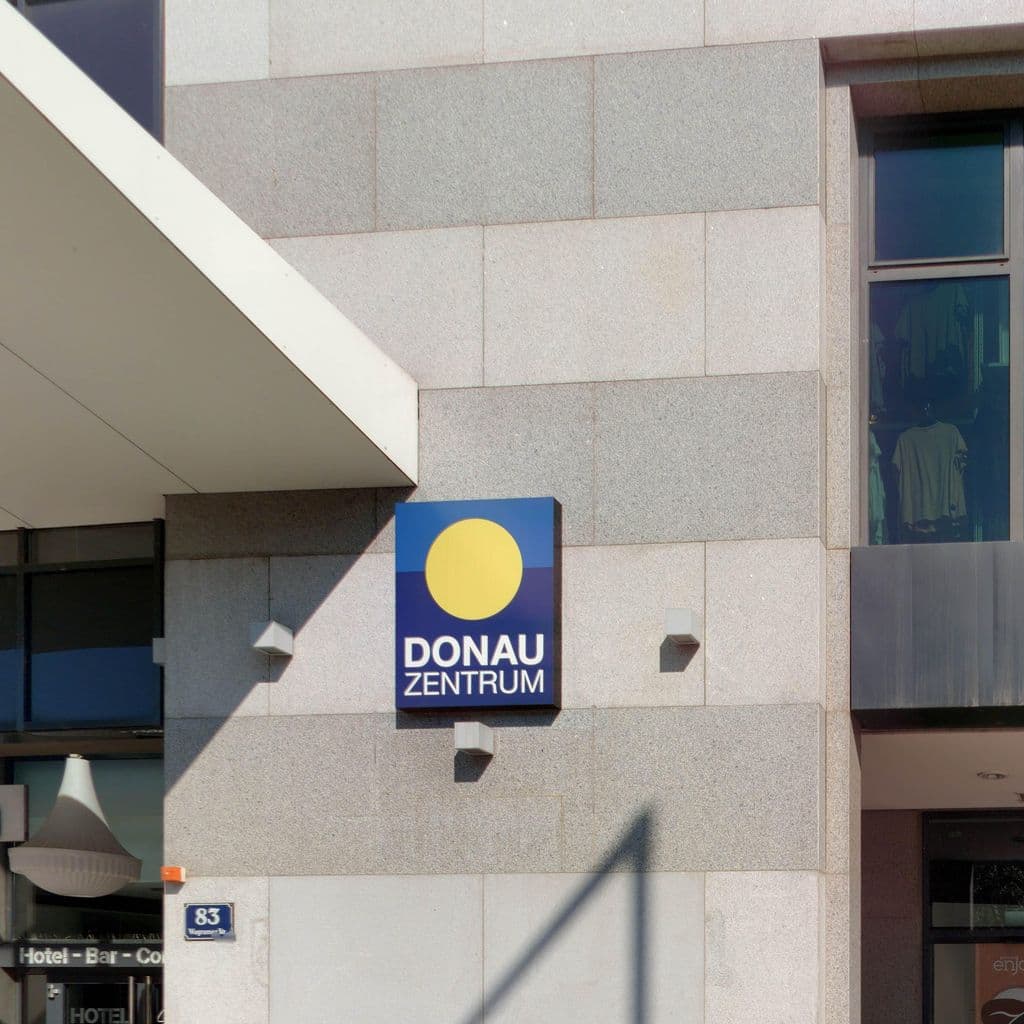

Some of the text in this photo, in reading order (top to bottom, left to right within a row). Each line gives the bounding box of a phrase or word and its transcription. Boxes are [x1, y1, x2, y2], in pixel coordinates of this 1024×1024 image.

[404, 634, 545, 668] DONAU
[404, 669, 545, 696] ZENTRUM
[195, 908, 220, 925] 83
[19, 947, 68, 965] Hotel
[85, 947, 118, 965] Bar
[70, 1007, 129, 1024] HOTEL
